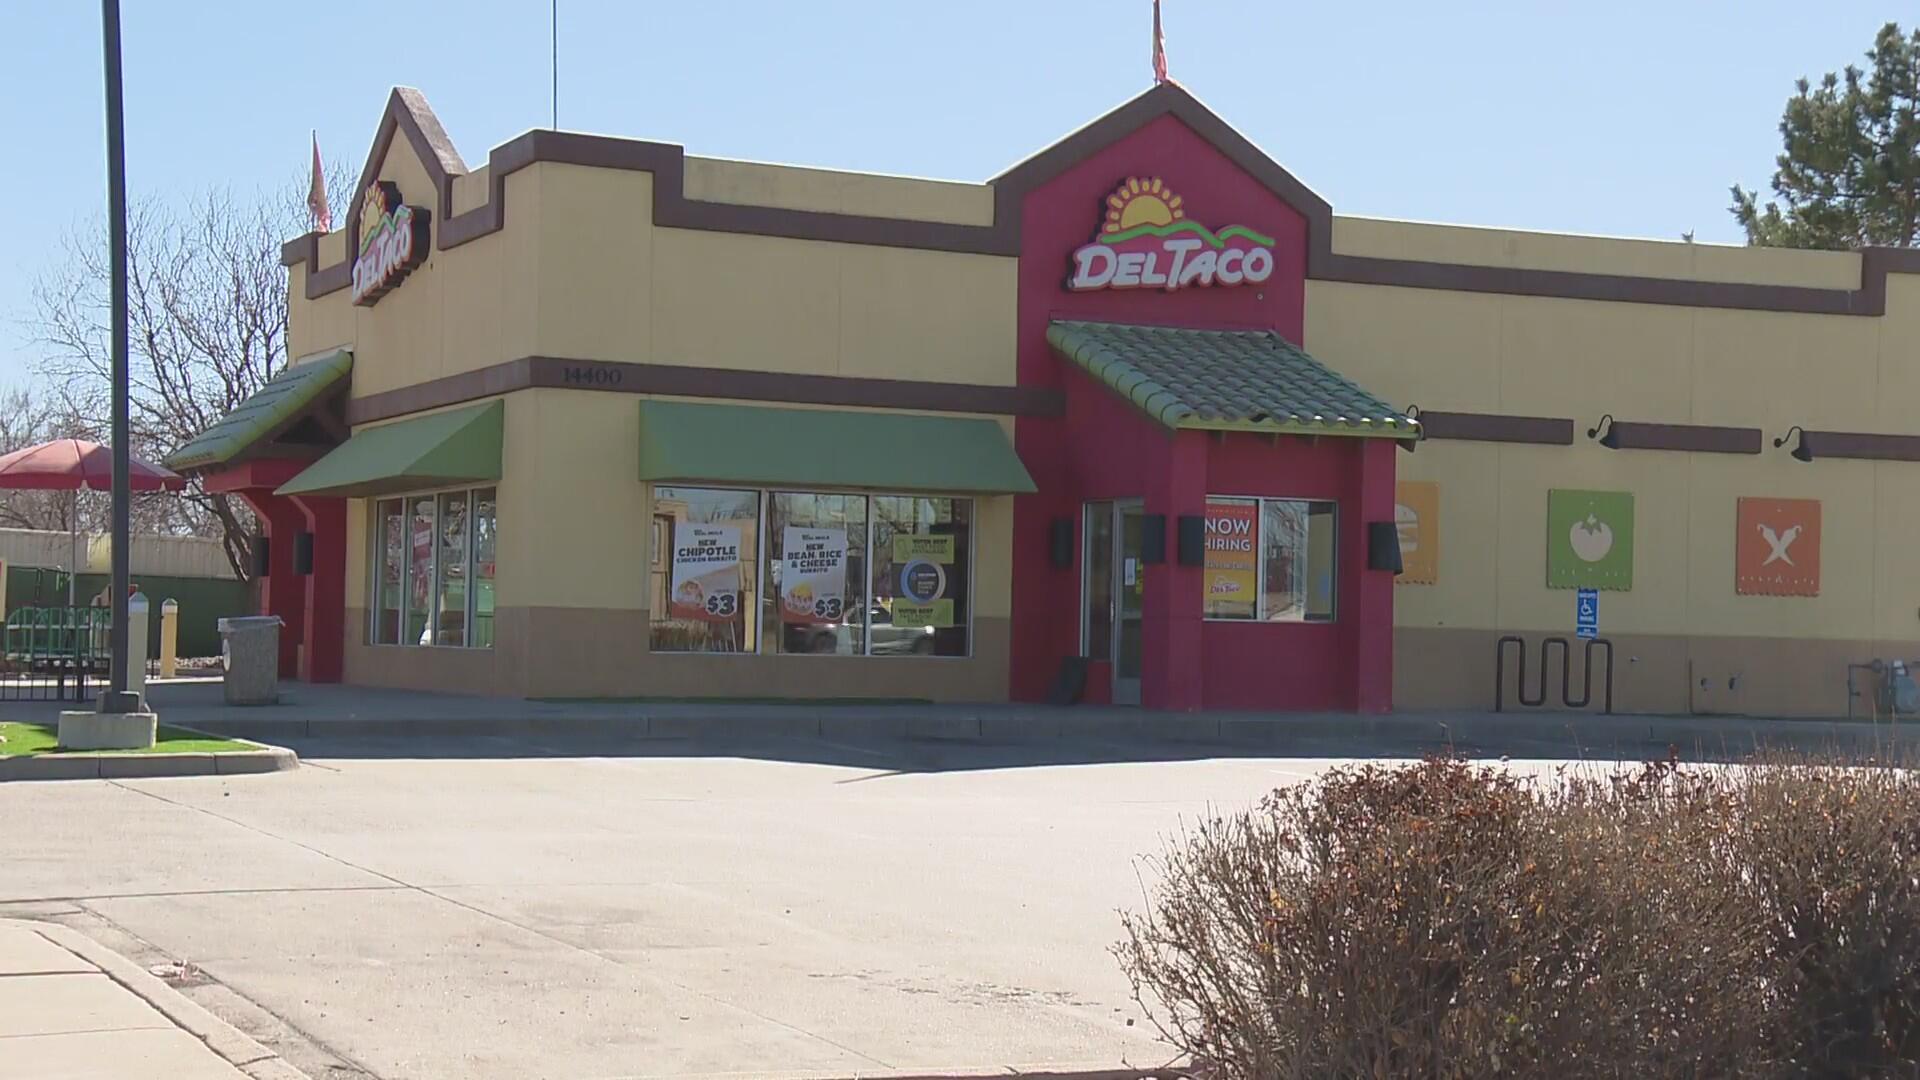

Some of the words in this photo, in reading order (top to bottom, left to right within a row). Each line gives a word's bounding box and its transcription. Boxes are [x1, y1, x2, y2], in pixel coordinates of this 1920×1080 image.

[563, 367, 622, 384] 14400
[1204, 518, 1250, 535] NOW
[678, 546, 737, 557] CHIPOTLE
[1205, 538, 1250, 551] HIRING
[819, 550, 842, 559] RICE
[800, 559, 837, 568] CHEESE
[707, 594, 735, 615] $3
[815, 598, 841, 618] $3
